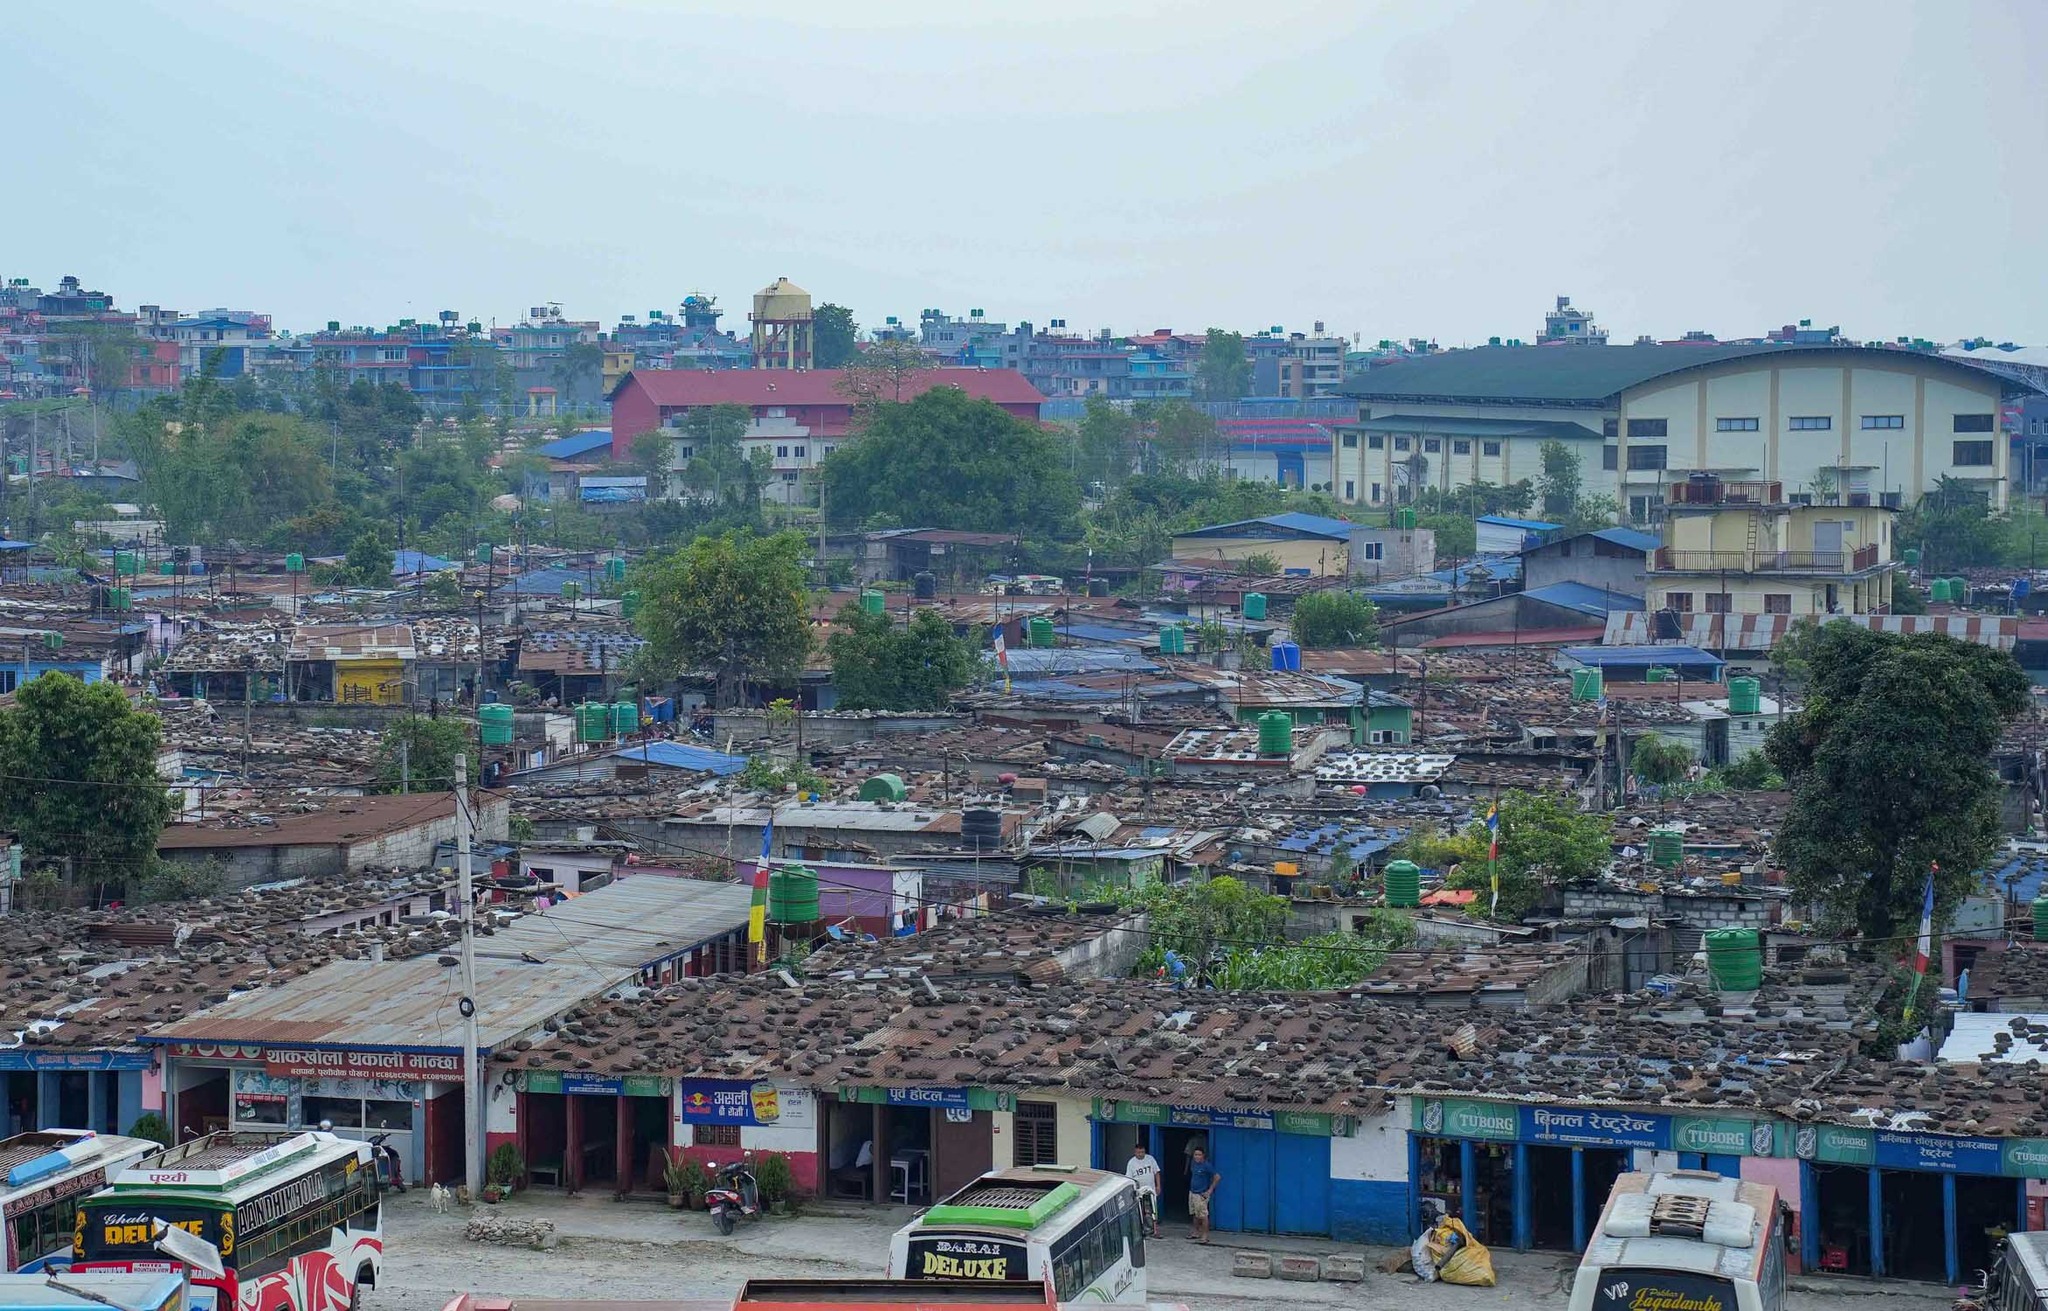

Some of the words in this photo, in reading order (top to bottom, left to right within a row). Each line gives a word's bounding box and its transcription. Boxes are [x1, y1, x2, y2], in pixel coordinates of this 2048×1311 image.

[267, 1049, 343, 1065] थाकखोला
[347, 1051, 404, 1068] थकाली
[409, 1054, 458, 1071] भान्छा
[714, 1090, 748, 1105] असली
[909, 1088, 943, 1101] होटल
[1459, 1114, 1513, 1131] TUBORG
[1534, 1109, 1584, 1128] बिमल
[1688, 1130, 1744, 1146] TUBORG
[1830, 1136, 1867, 1148] TUBORG
[2015, 1152, 2048, 1162] TUBOR
[1136, 1166, 1151, 1176] 1977
[238, 1172, 325, 1237] AANDHIKHOLA
[104, 1212, 149, 1225] Ghale
[105, 1220, 203, 1245] DELXE
[937, 1242, 1000, 1255] DARAI
[923, 1251, 1007, 1280] DELUXE
[1603, 1281, 1629, 1301] VIP
[1629, 1288, 1722, 1311] Jagadamba
